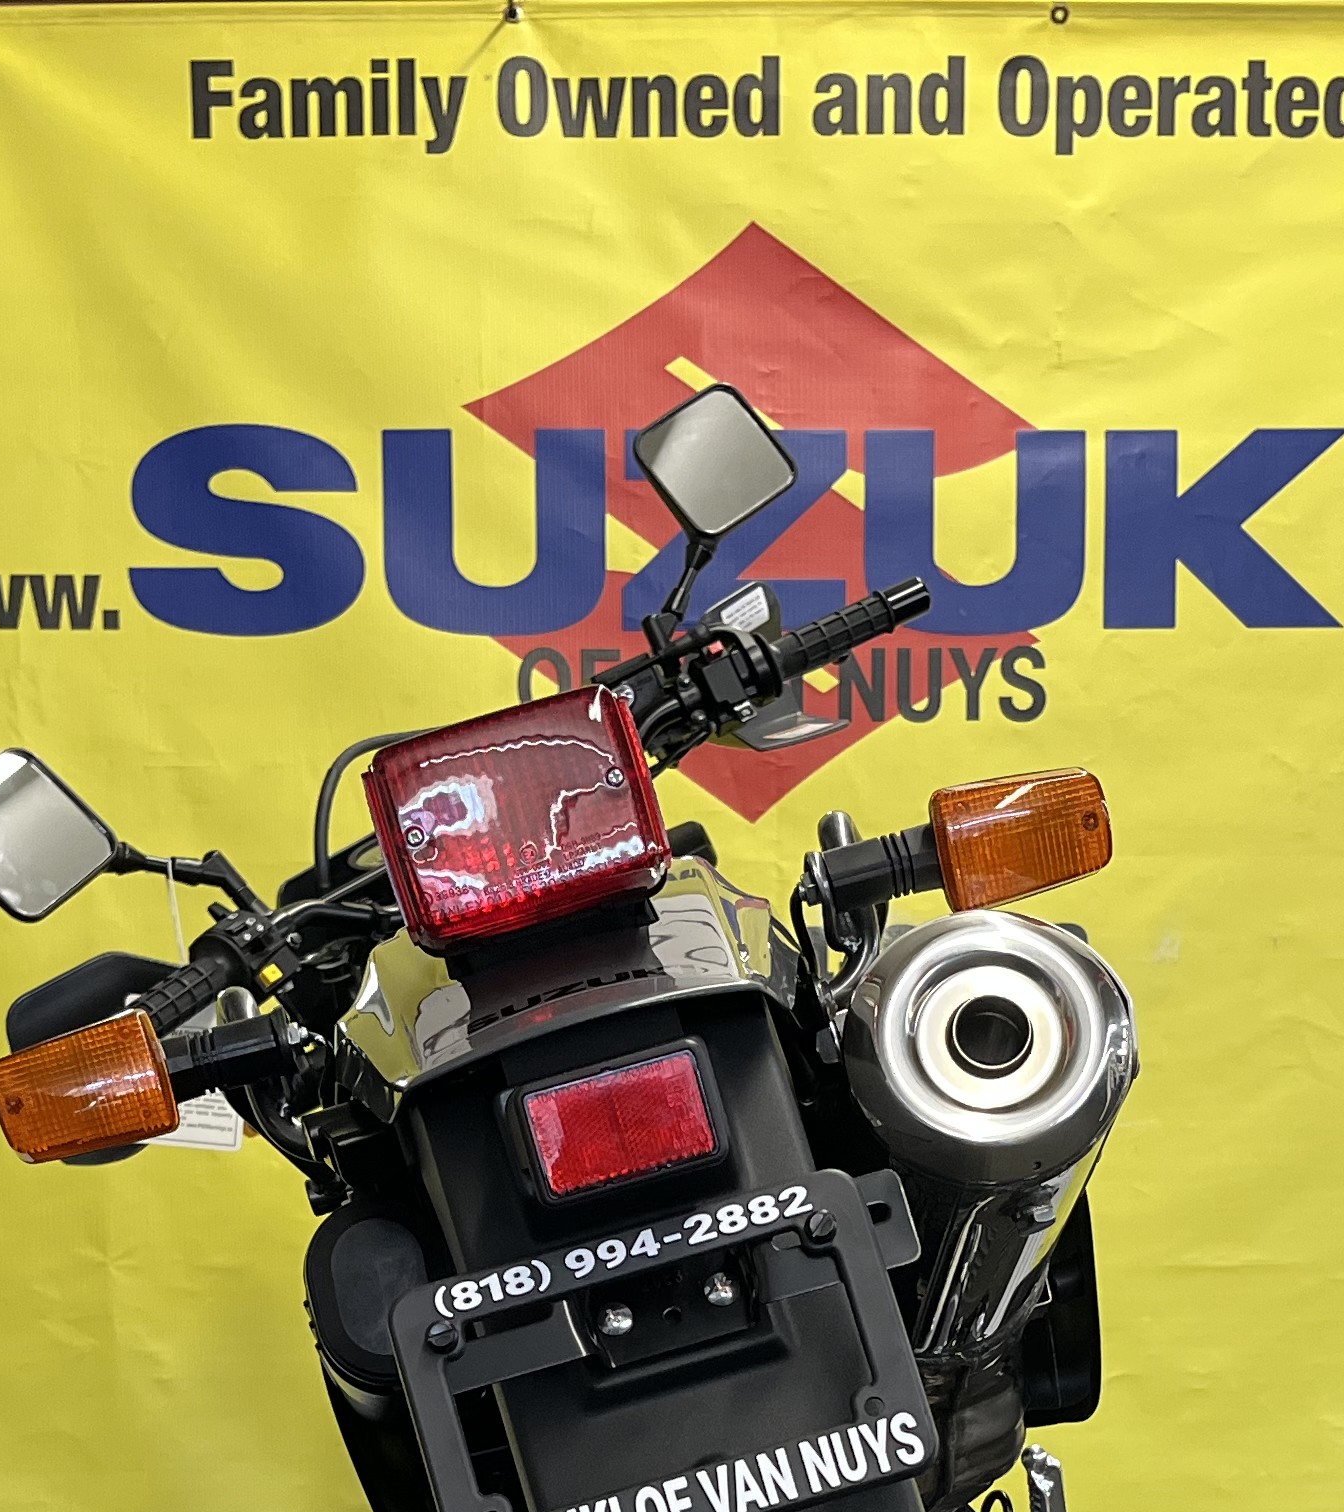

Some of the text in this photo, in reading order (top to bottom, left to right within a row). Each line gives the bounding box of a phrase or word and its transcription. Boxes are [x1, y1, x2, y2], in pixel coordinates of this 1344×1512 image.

[189, 58, 468, 154] Family
[497, 55, 780, 138] Owned
[812, 55, 965, 136] and
[838, 646, 1047, 723] NUYS
[434, 1185, 814, 1318] (818) 994-2882
[797, 1411, 925, 1494] NUYS
